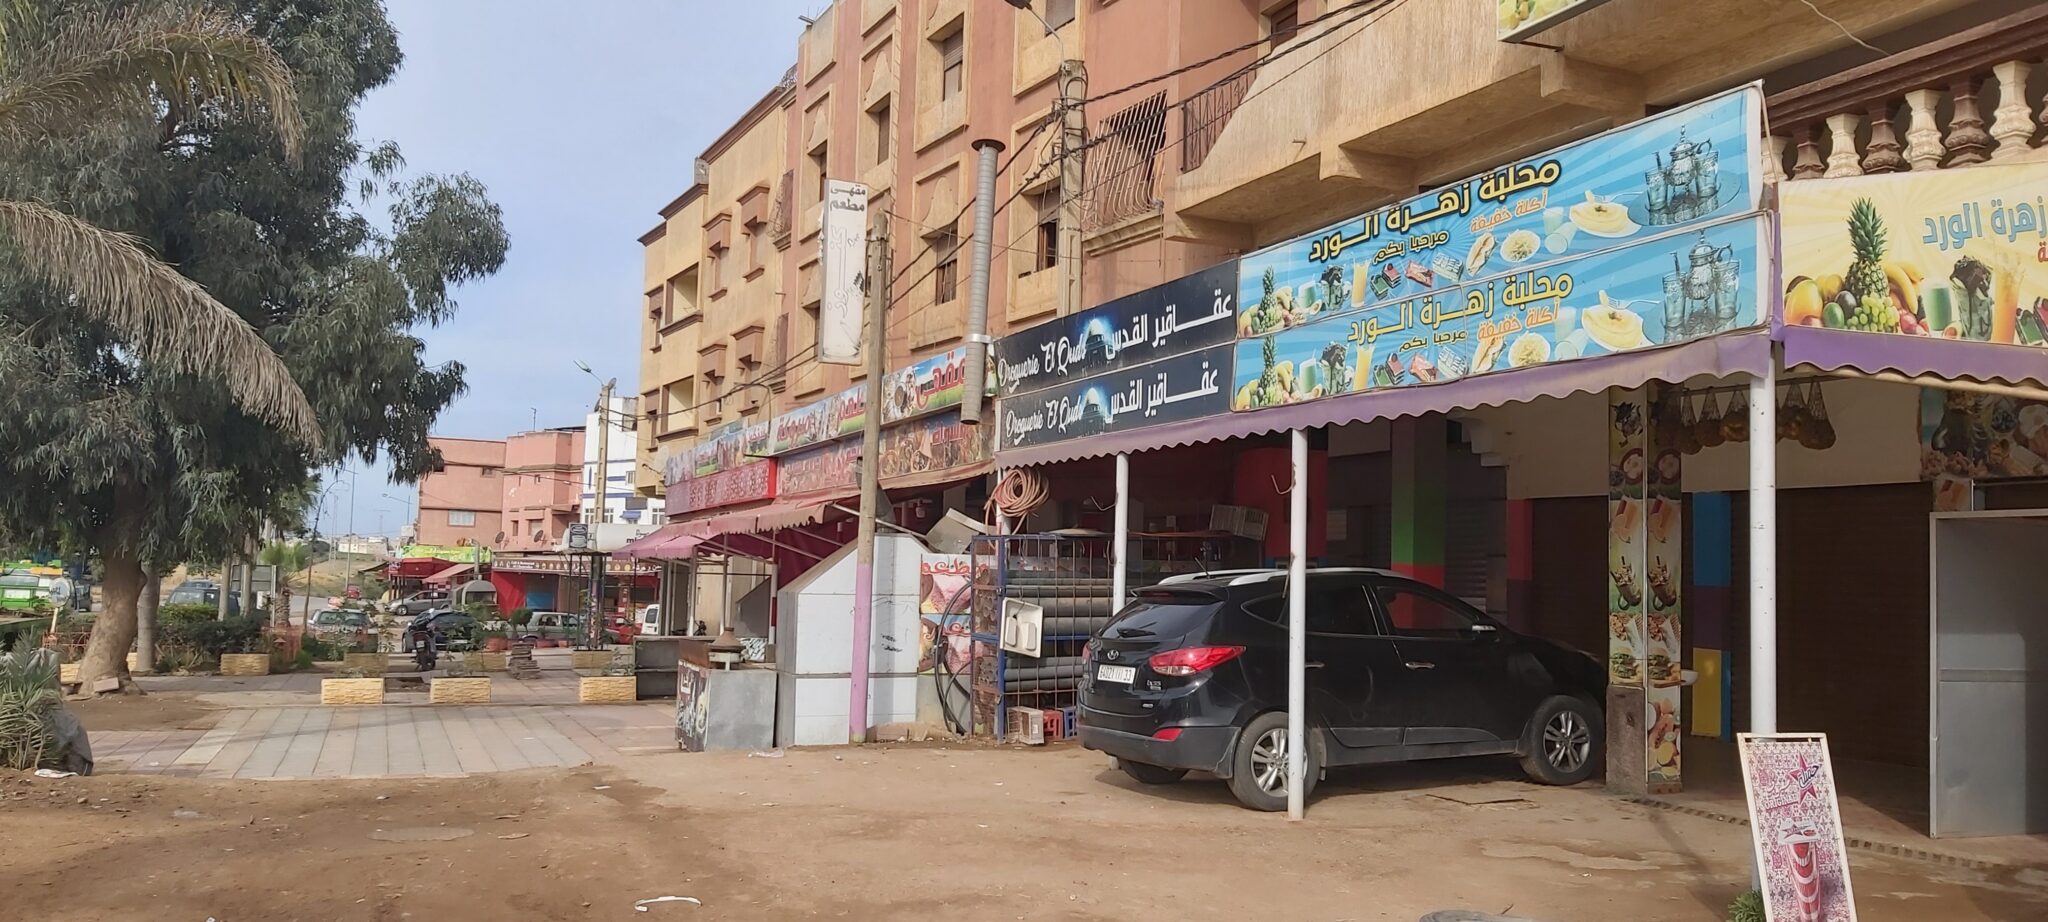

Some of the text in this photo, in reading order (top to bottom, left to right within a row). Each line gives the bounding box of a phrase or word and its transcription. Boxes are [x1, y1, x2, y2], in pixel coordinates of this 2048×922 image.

[1309, 159, 1562, 261] محلبة زهرة الورد
[1470, 190, 1548, 233] أكلة خفيفة
[1923, 195, 2047, 250] زهرة الورد
[1374, 231, 1449, 264] مرحبا بكم
[1105, 289, 1233, 360] عقاقير القدس
[1348, 270, 1573, 345] محلبة زهرة الورد
[1477, 297, 1560, 340] أكلة خفيفة
[1400, 330, 1467, 352] مرحبا بكم
[998, 354, 1040, 393] Droguerie
[1041, 342, 1056, 373] El
[1105, 361, 1219, 424] عقاقير القدس
[1006, 409, 1044, 446] Droguerie
[1046, 399, 1059, 429] El
